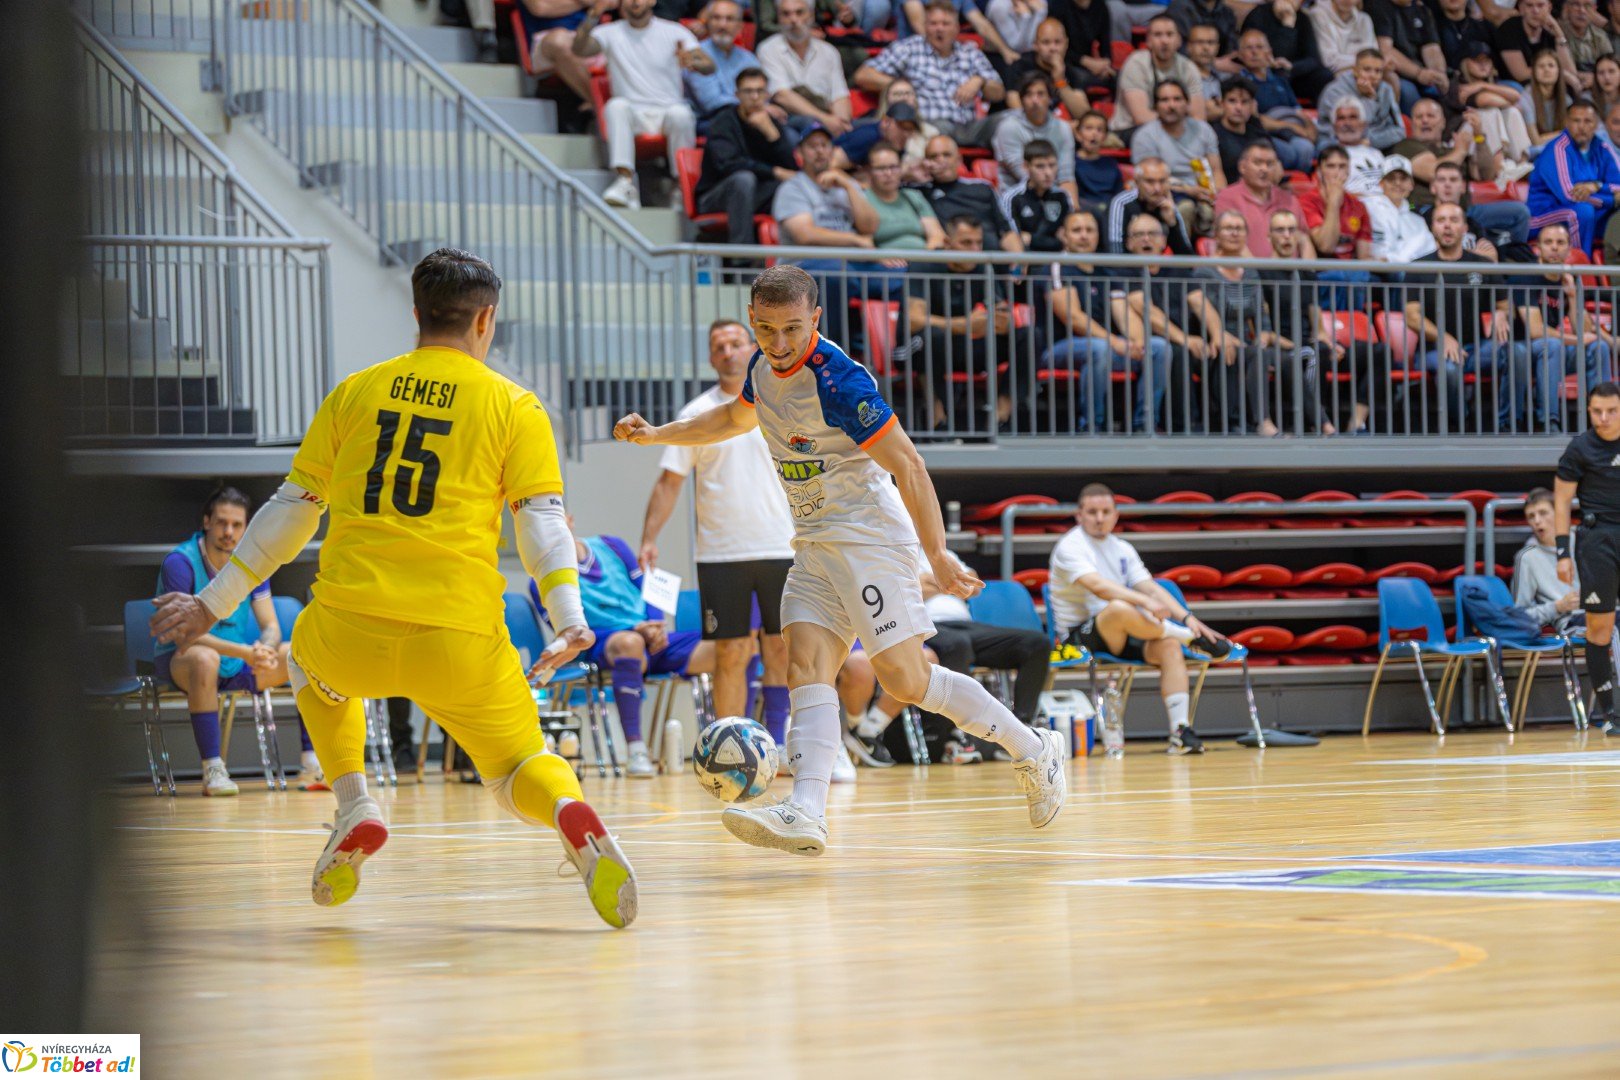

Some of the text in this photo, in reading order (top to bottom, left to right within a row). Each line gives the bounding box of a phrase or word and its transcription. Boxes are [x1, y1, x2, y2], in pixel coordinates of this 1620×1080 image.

[390, 373, 457, 409] GÉMESI
[364, 409, 453, 517] 15
[862, 584, 884, 619] 9
[874, 620, 897, 636] JAKO
